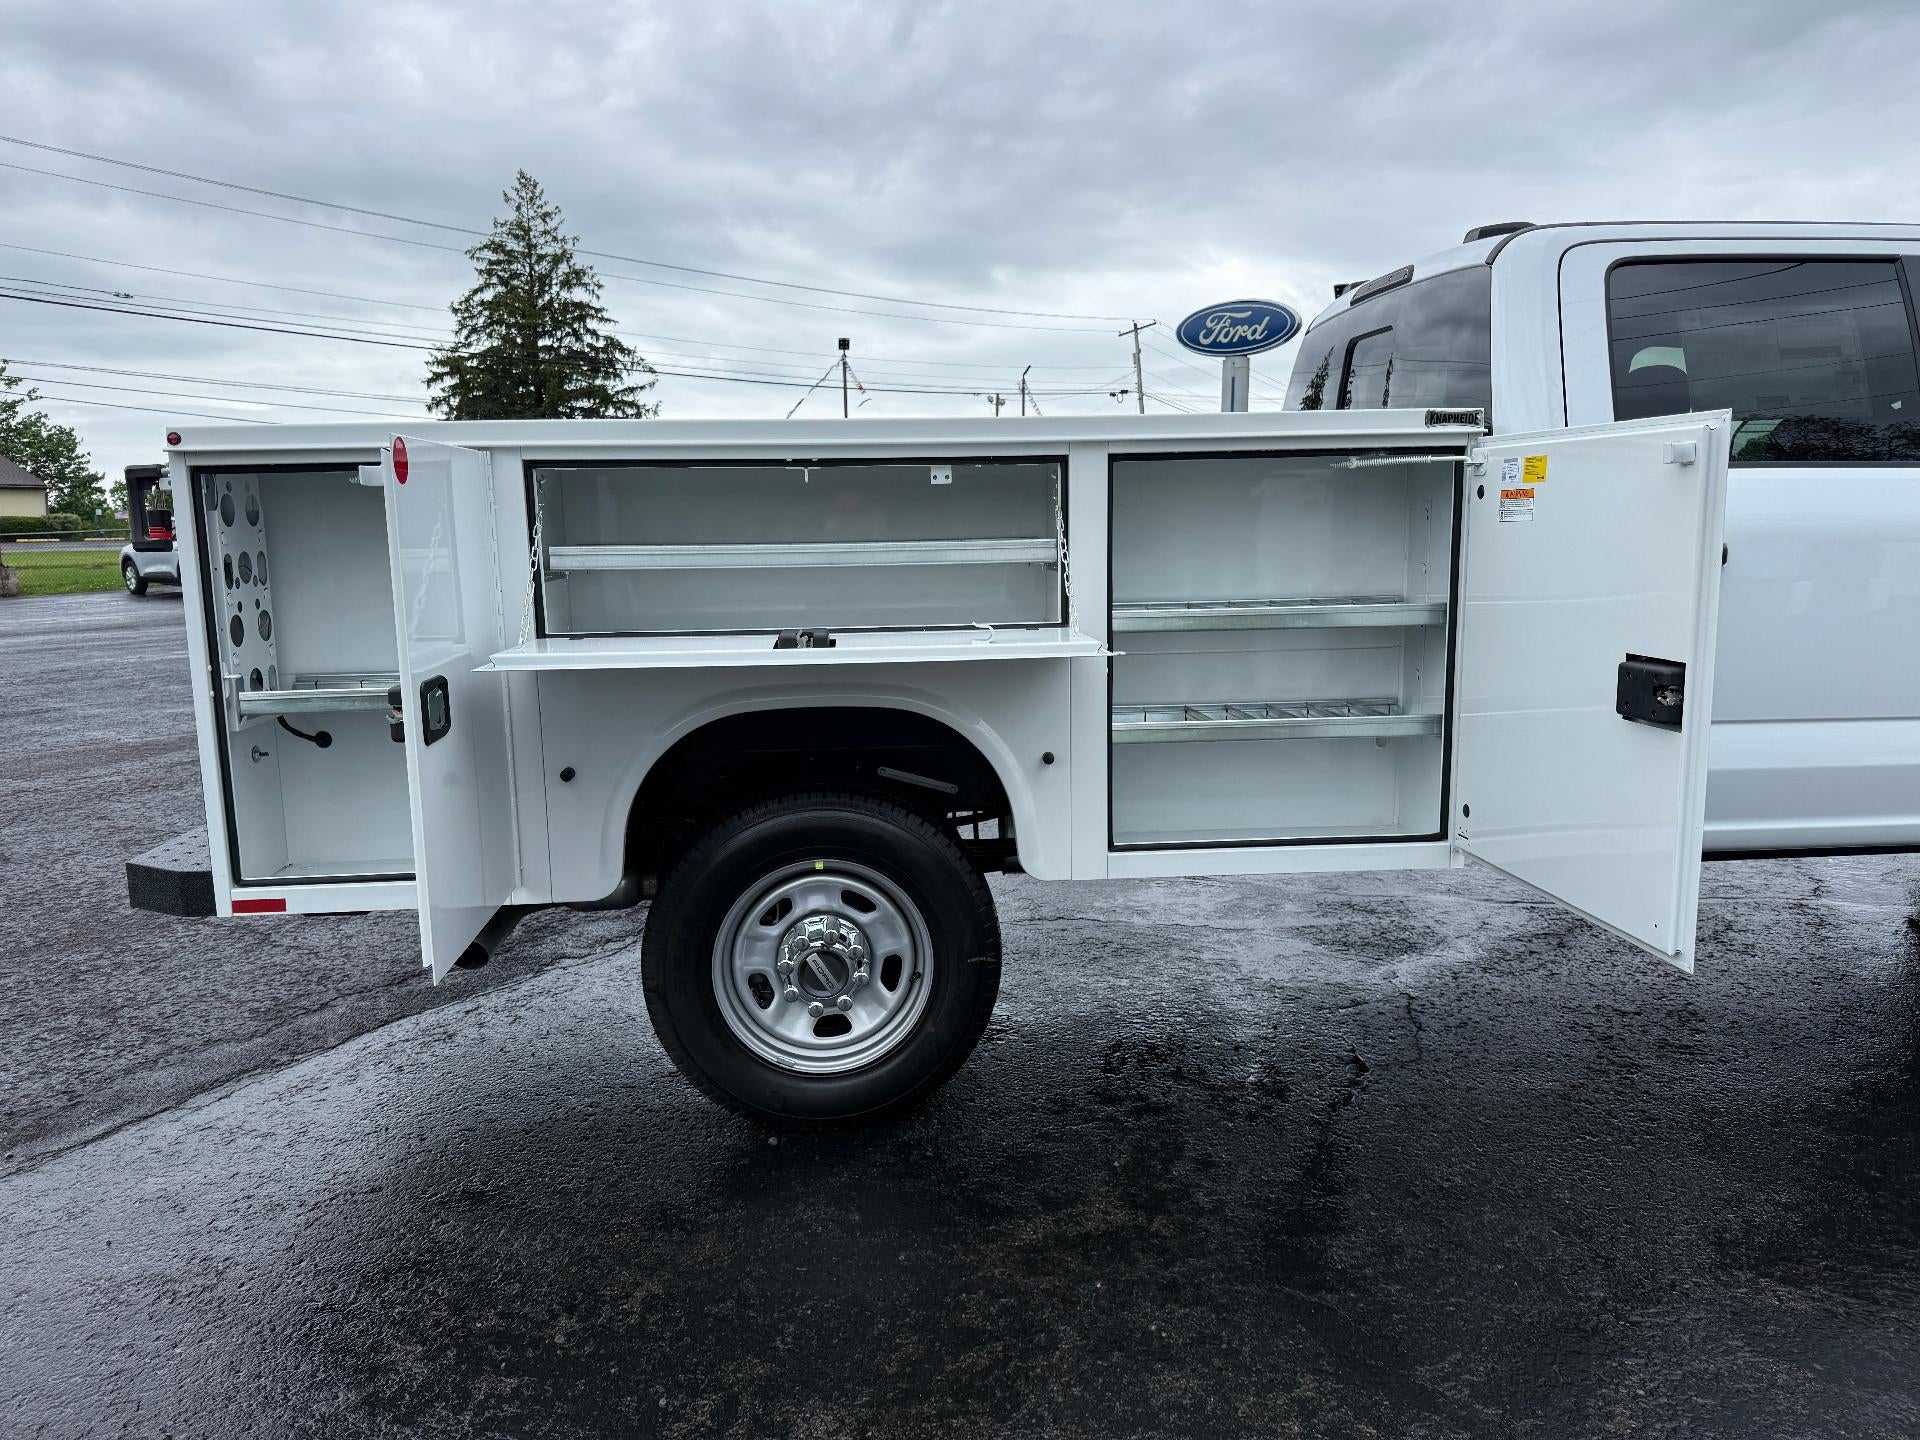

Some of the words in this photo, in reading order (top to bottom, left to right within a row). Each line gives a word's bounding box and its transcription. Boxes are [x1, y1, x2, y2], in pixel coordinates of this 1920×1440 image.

[1199, 311, 1270, 345] Ford
[1429, 412, 1480, 425] KNAPHEIDE
[812, 960, 834, 989] FORD
